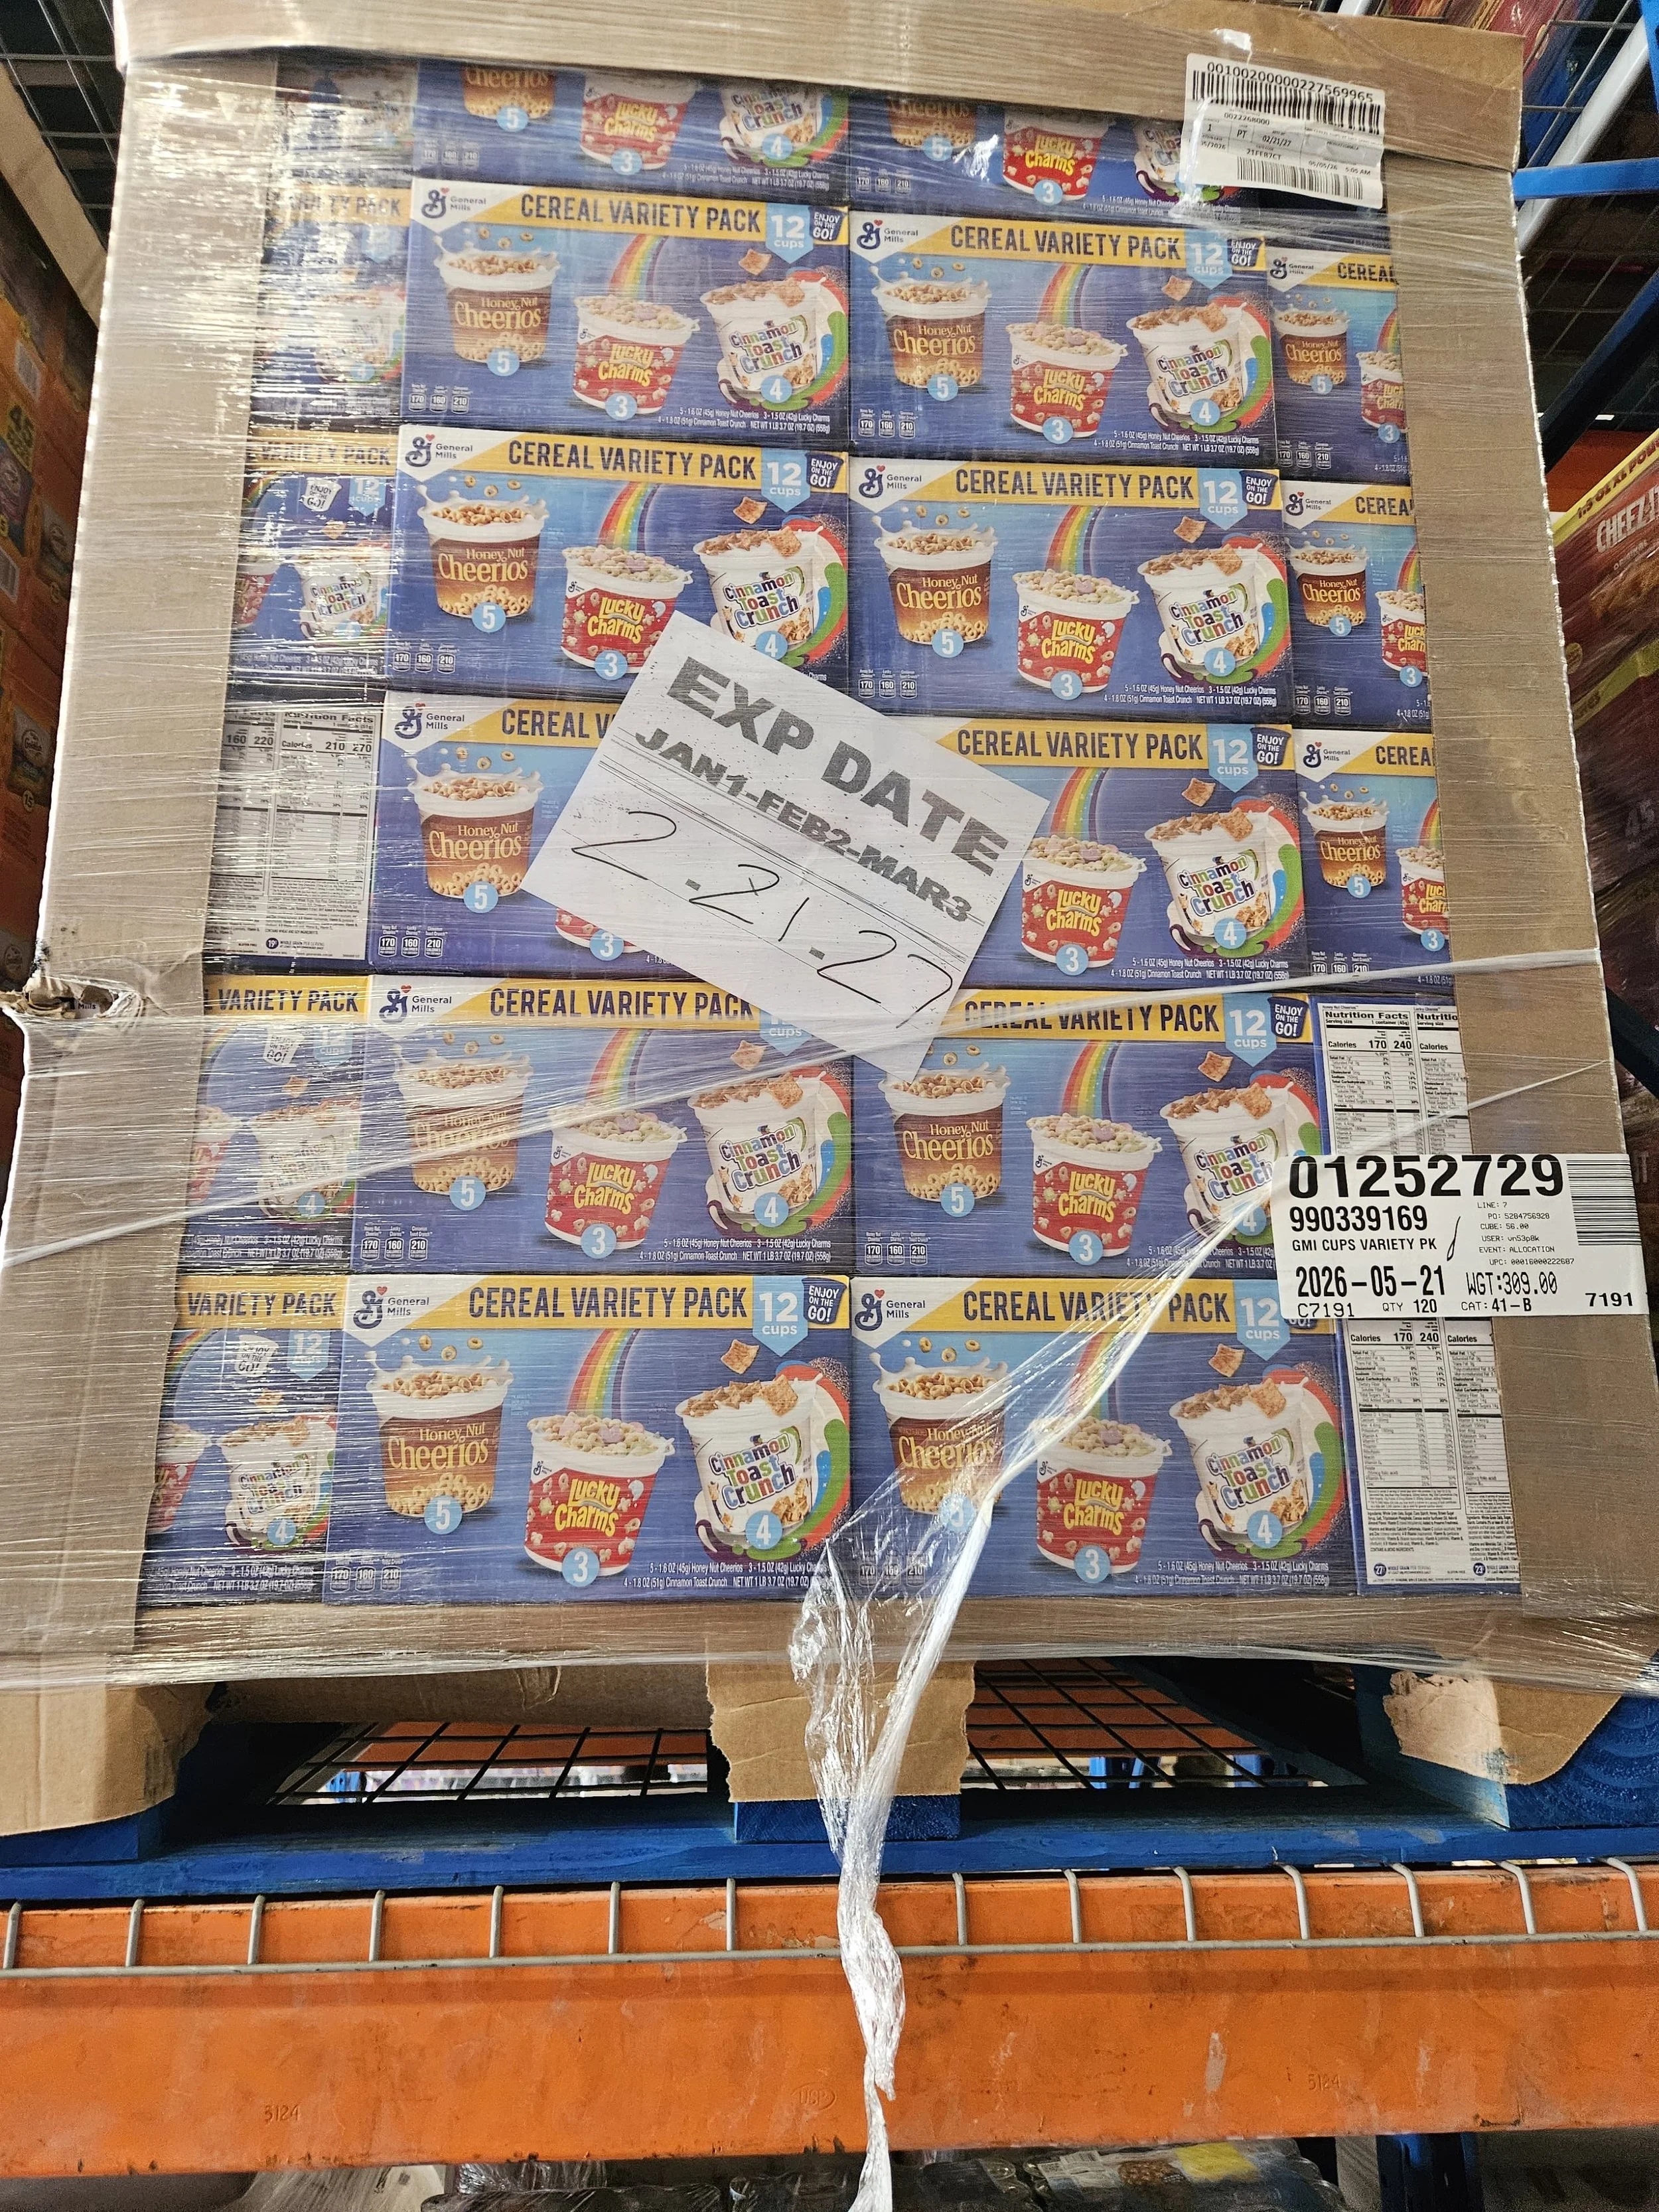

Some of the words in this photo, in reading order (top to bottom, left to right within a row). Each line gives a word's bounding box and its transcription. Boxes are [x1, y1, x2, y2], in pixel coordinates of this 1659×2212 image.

[1035, 134, 1076, 159] Lucky
[1237, 129, 1247, 138] PT
[1262, 135, 1291, 147] 02/21/27
[1025, 151, 1076, 175] Charms
[521, 194, 605, 222] CEREAL
[608, 200, 699, 228] VARIETY
[706, 207, 762, 233] PACK
[951, 225, 1030, 252] CEREAL
[1035, 230, 1121, 256] VARIETY
[1128, 236, 1181, 259] PACK
[453, 302, 541, 330] Cheerios
[893, 330, 975, 357] Cheerios
[436, 443, 473, 452] General
[508, 440, 595, 470] CEREAL
[598, 446, 693, 475] VARIETY
[699, 453, 757, 480] PACK
[956, 469, 1038, 495] CEREAL
[1042, 472, 1131, 497] VARIETY
[1139, 475, 1194, 499] PACK
[1204, 480, 1238, 504] 12
[1246, 477, 1271, 487] ENJOY
[1208, 506, 1238, 515] cups
[1246, 492, 1266, 504] GO!
[922, 577, 958, 588] Honey
[962, 575, 977, 585] Nut
[1303, 582, 1360, 603] Cheerios
[897, 583, 981, 611] Cheerios
[1170, 590, 1237, 618] Cinnamon
[1183, 612, 1244, 645] Crunch
[1185, 606, 1232, 629] Toast
[942, 631, 954, 654] 5
[1052, 619, 1096, 646] Lucky
[1041, 639, 1096, 664] Charms
[1214, 651, 1226, 673] 4
[1060, 674, 1072, 698] 3
[1244, 687, 1257, 696] Lucky
[255, 736, 273, 745] 220
[326, 742, 345, 751] 210
[958, 729, 1042, 757] CEREAL
[1046, 731, 1139, 758] VARIETY
[1146, 734, 1202, 759] PACK
[1213, 739, 1249, 765] 12
[667, 657, 815, 755] EXP
[821, 741, 1009, 876] DATE
[457, 825, 496, 837] Honey
[500, 823, 519, 834] Nut
[636, 728, 973, 923] JAN1-FEB2-MAR3
[427, 831, 522, 861] Cheerios
[1321, 841, 1381, 863] Cheerios
[218, 989, 303, 1011] VARIETY
[307, 990, 358, 1012] PACK
[586, 990, 686, 1019] VARIETY
[693, 994, 755, 1021] PACK
[1160, 1005, 1219, 1031] PACK
[1230, 1010, 1267, 1037] 12
[1325, 1011, 1374, 1019] Nutrition
[1369, 1039, 1387, 1049] 170
[1394, 1040, 1411, 1049] 240
[720, 1125, 794, 1159] Cinnamon
[902, 1130, 993, 1162] Cheerios
[735, 1143, 788, 1171] Toast
[732, 1150, 800, 1191] Crunch
[1289, 1154, 1563, 1199] 01252729
[1289, 1205, 1427, 1232] 990339169
[1292, 1240, 1317, 1251] GMI
[1323, 1239, 1356, 1251] CUPS
[1360, 1238, 1414, 1250] VARIETY
[1420, 1238, 1437, 1250] PK
[1466, 1271, 1557, 1295] WGT:309.00
[188, 1291, 277, 1316] VARIETY
[283, 1292, 336, 1316] PACK
[470, 1286, 567, 1317] CEREAL
[570, 1287, 676, 1317] VARIETY
[683, 1288, 748, 1317] PACK
[964, 1291, 1055, 1321] CEREAL
[1297, 1302, 1354, 1317] C7191
[1382, 1303, 1403, 1312] QTY
[1413, 1299, 1437, 1313] 120
[1461, 1301, 1487, 1311] CAT:
[1492, 1297, 1532, 1312] 41-B
[1585, 1292, 1633, 1307] 7191
[1394, 1333, 1412, 1342] 170
[1420, 1333, 1439, 1342] 240
[567, 1479, 620, 1512] Lucky
[553, 1506, 620, 1537] Charms
